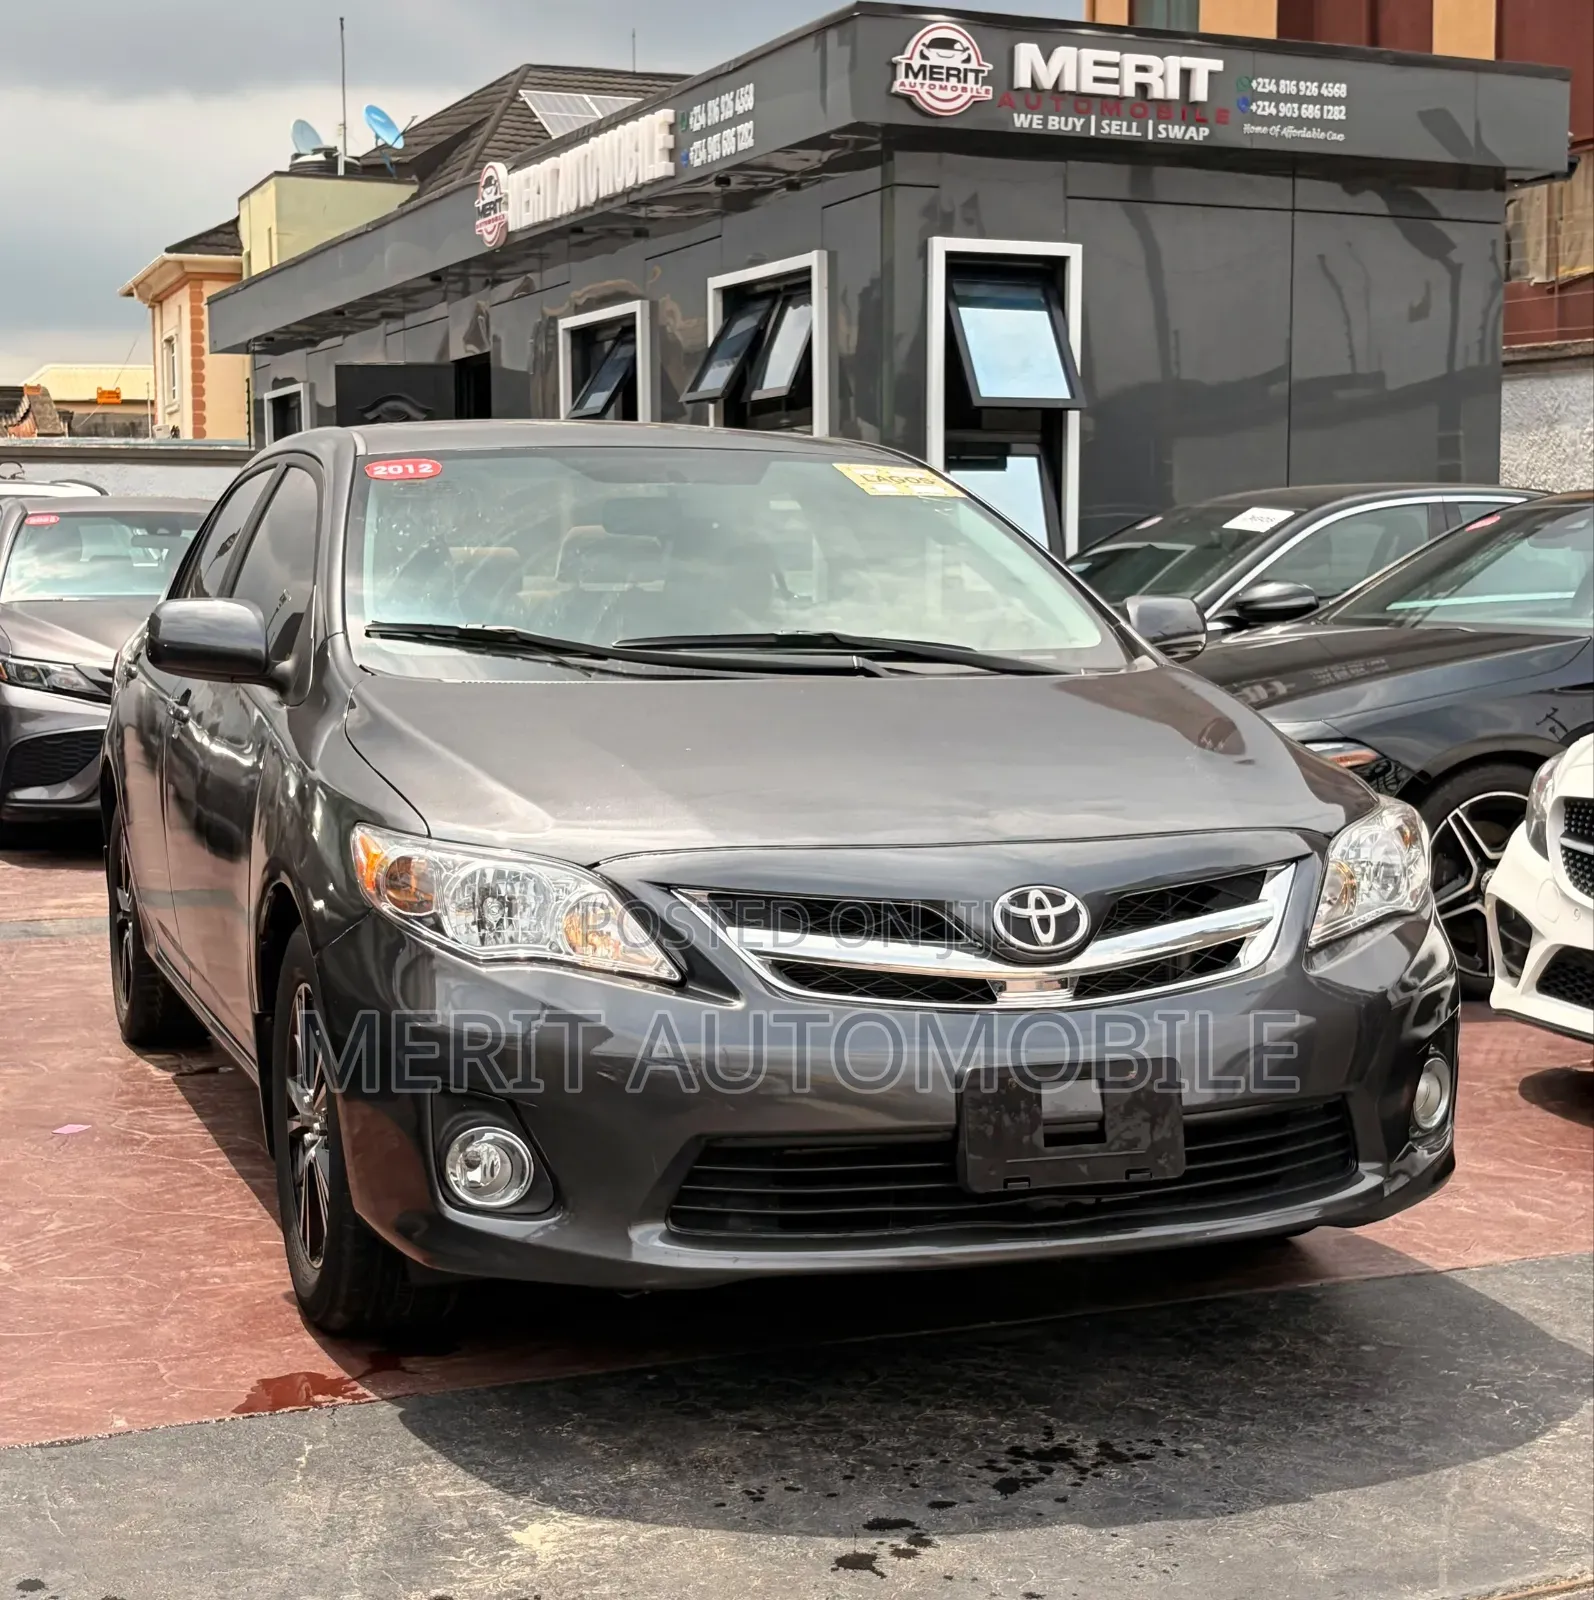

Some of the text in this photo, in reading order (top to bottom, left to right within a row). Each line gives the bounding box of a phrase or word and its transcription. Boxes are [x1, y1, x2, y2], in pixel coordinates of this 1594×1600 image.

[903, 62, 986, 85] MERIT
[1013, 42, 1224, 103] MERIT
[898, 80, 992, 96] AUTOMOBILE
[1251, 77, 1348, 98] +234 816 926 4568
[997, 91, 1231, 125] AUTOMOBILE
[1250, 100, 1347, 121] +234 903 686 1282
[1013, 113, 1044, 129] WE
[1047, 117, 1086, 131] BUY
[1100, 120, 1142, 137] SELL
[1157, 124, 1210, 141] SWAP
[1243, 123, 1268, 135] Home
[1268, 125, 1281, 138] Of
[1280, 126, 1326, 139] Affordable
[558, 109, 675, 216] AUTOMOBILE
[374, 464, 433, 475] 2012
[861, 474, 935, 485] LAGOS
